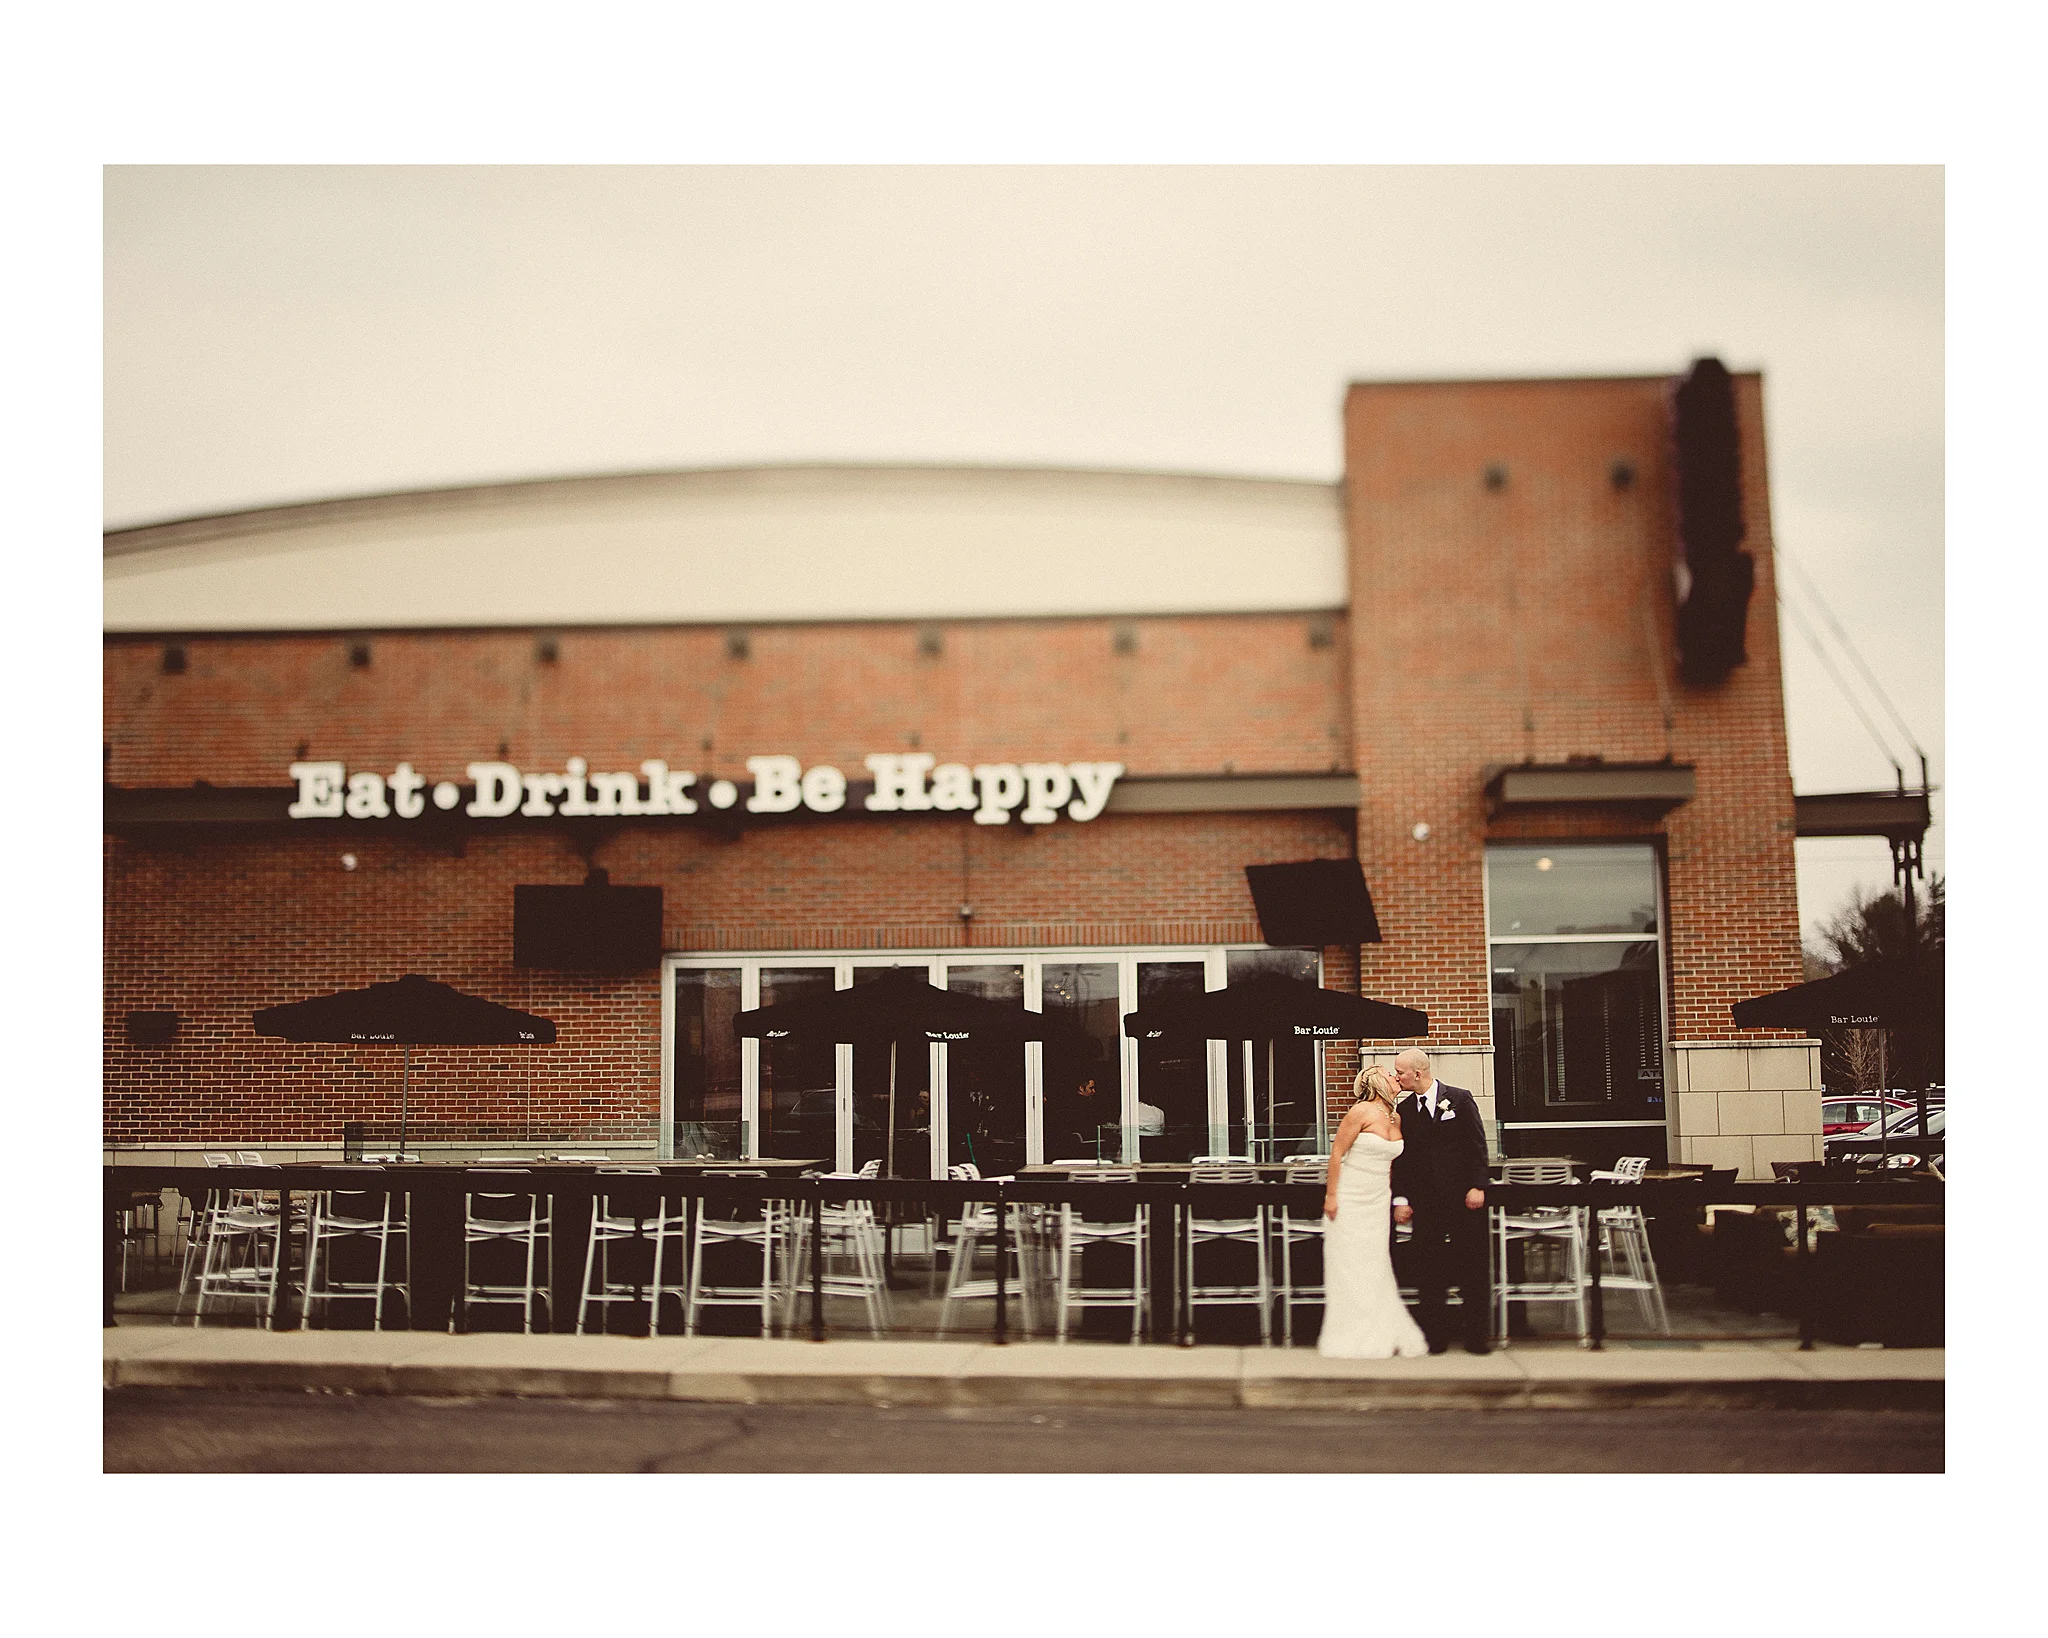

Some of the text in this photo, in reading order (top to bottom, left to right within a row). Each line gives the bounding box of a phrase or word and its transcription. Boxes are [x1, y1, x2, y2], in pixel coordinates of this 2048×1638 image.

[288, 753, 1126, 825] Eat Drink Be Happy
[1830, 1015, 1879, 1024] Bar Louie
[1293, 1025, 1340, 1035] Bar Louie
